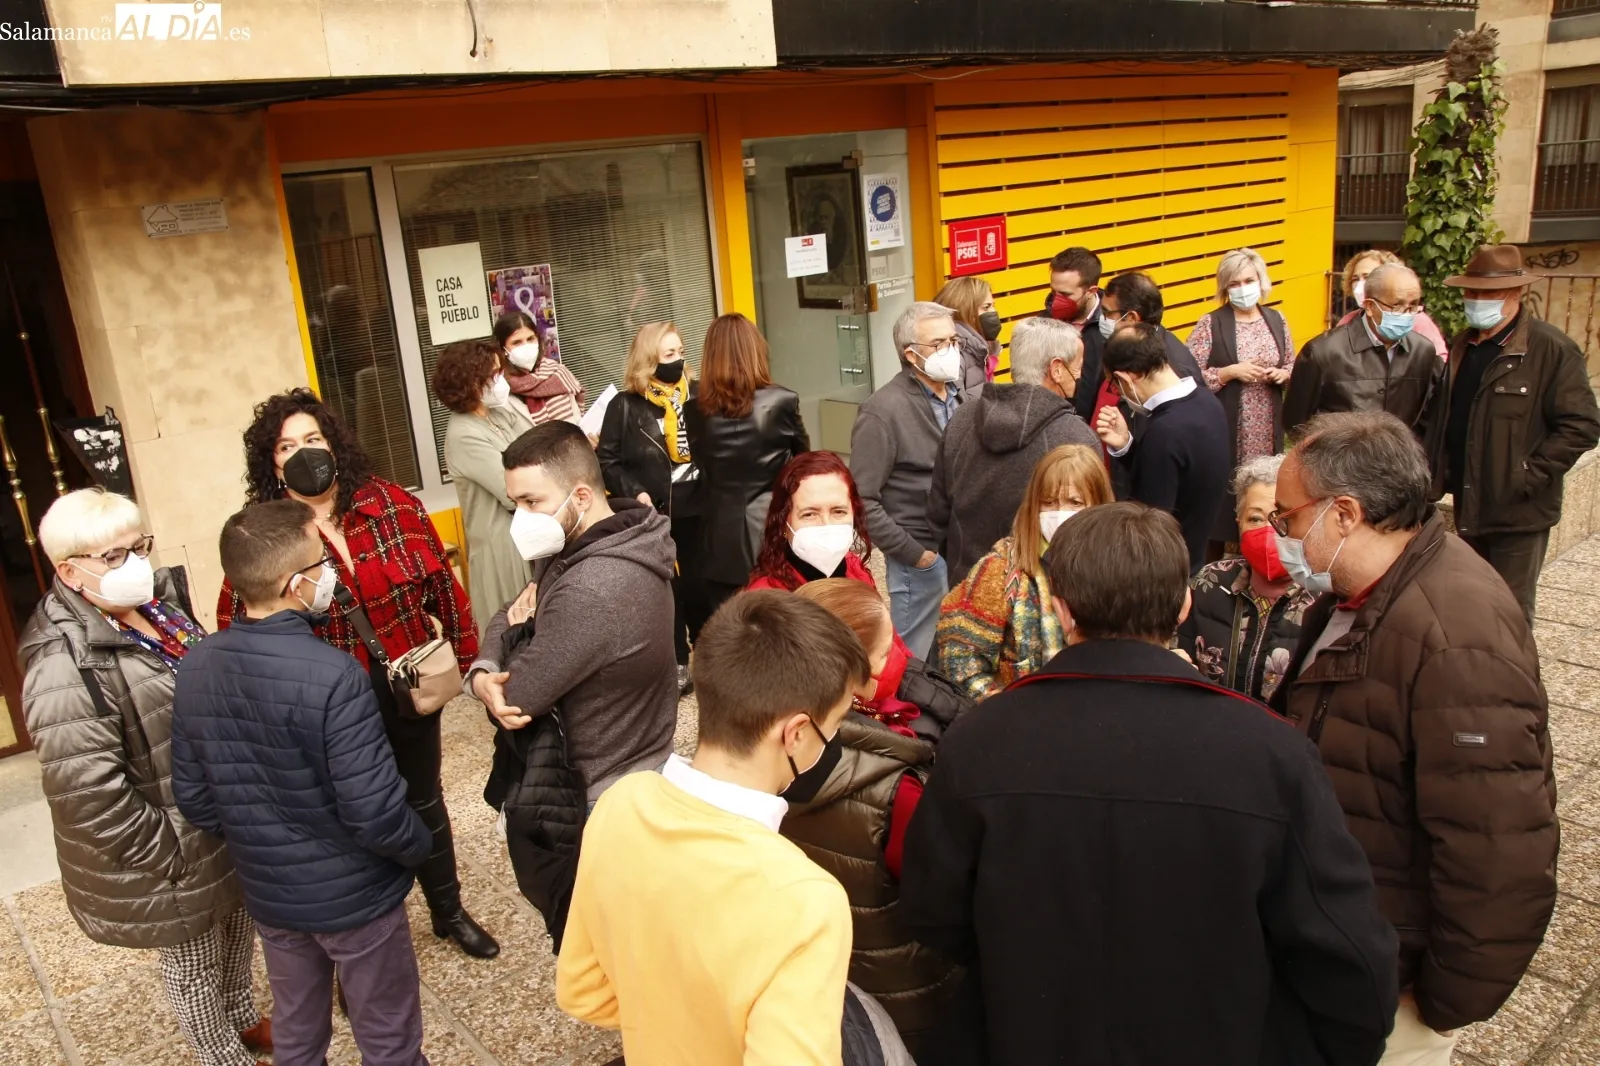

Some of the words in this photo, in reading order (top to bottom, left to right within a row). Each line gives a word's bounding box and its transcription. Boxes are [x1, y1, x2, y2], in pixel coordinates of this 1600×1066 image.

[957, 246, 978, 260] PSOE
[436, 276, 463, 292] CASA
[438, 293, 458, 309] DEL
[441, 305, 479, 324] PUEBLO
